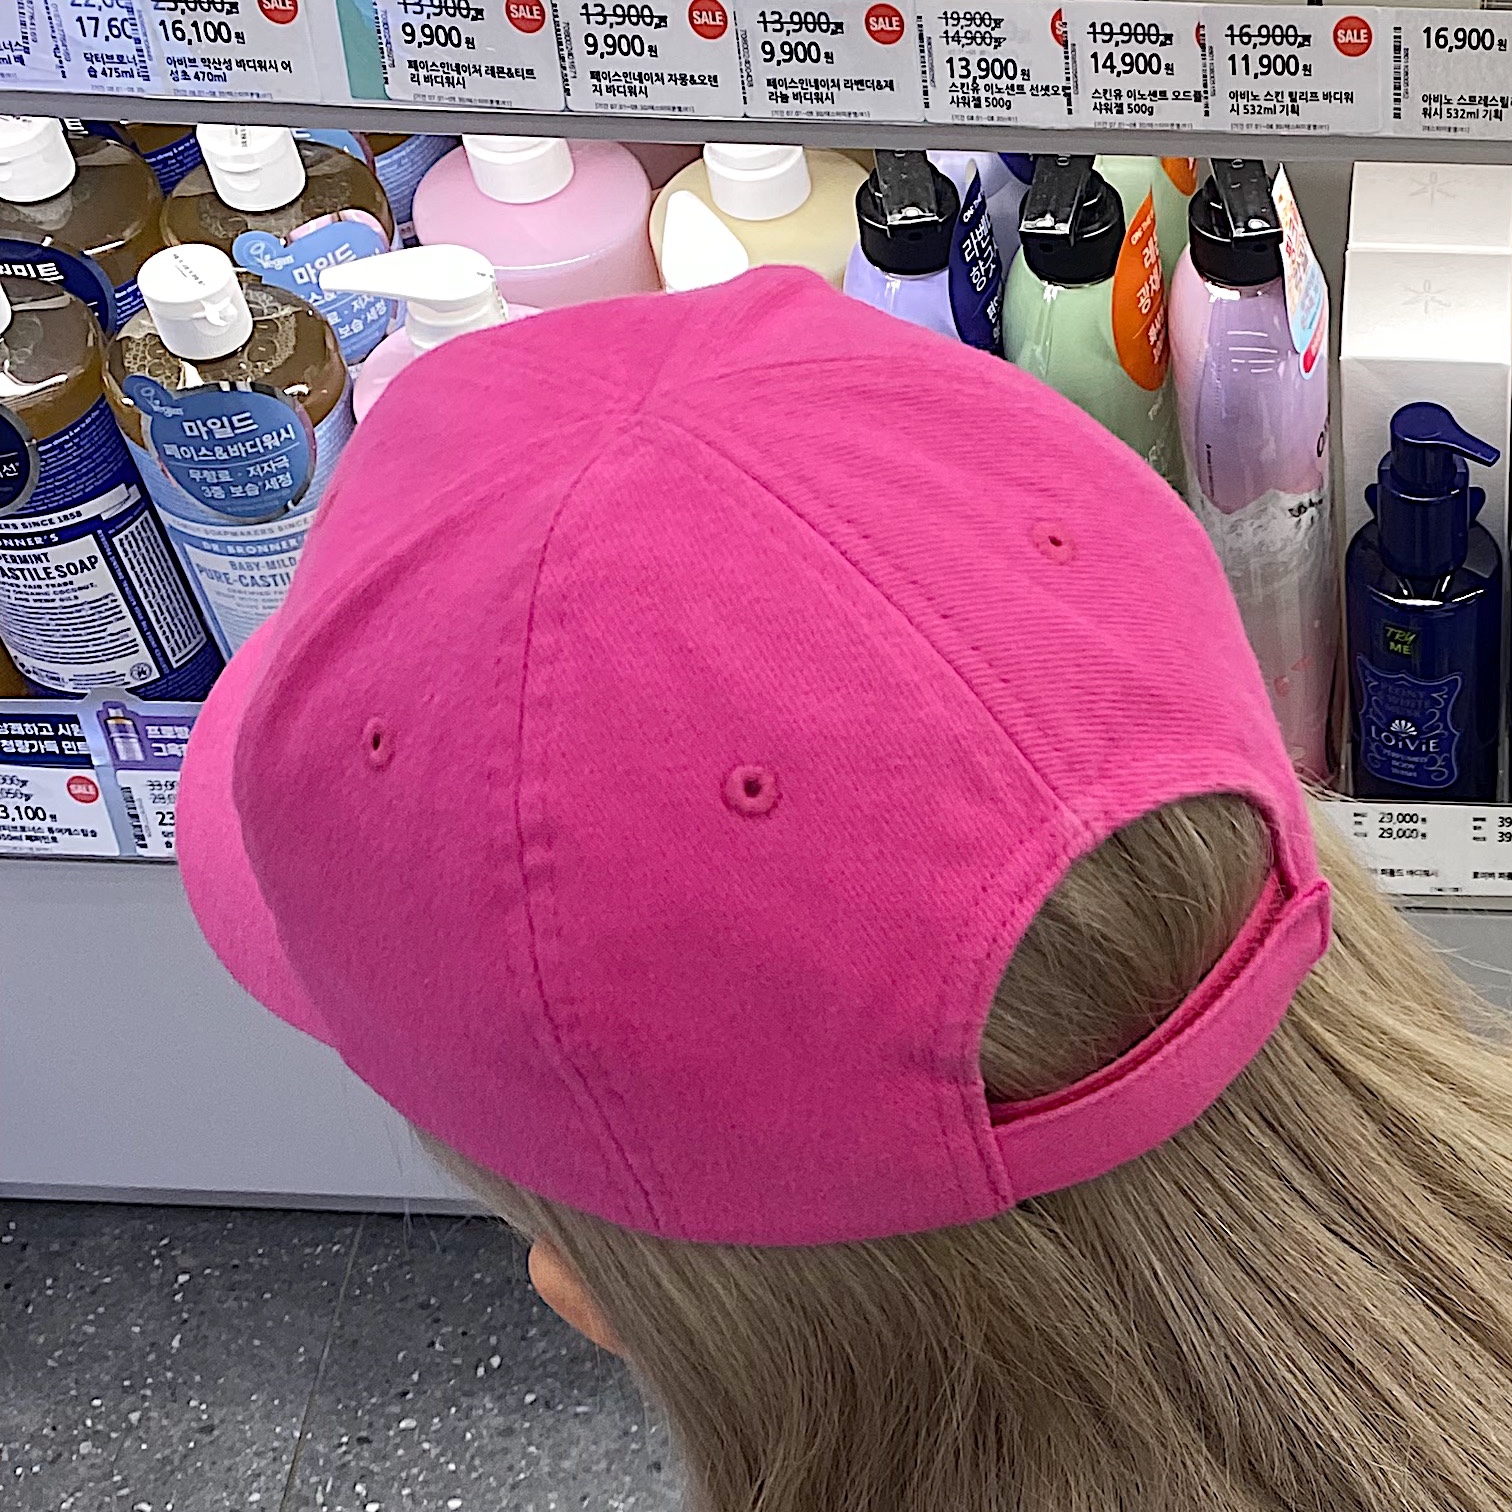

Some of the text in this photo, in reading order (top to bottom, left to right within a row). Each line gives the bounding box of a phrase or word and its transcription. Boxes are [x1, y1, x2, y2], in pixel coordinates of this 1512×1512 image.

[509, 5, 542, 20] SALE
[690, 9, 724, 26] SALE
[158, 19, 246, 46] 16,100원
[868, 15, 901, 33] SALE
[400, 22, 477, 50] 9,900원
[1335, 27, 1369, 44] SALE
[1422, 26, 1508, 54] 16,900원
[583, 32, 659, 60] 9,900원
[760, 40, 835, 68] 9,900원
[235, 58, 280, 74] 바디워시
[944, 56, 1031, 84] 13,900원
[1089, 51, 1175, 78] 14,900원
[1227, 52, 1313, 80] 11,900원
[193, 69, 228, 84] 470ml
[421, 73, 467, 90] 바디워시
[605, 84, 649, 100] 바디워시
[790, 91, 835, 106] 바디워시
[1227, 89, 1355, 104] 아비노 스킨 릴리프 바디워
[1420, 93, 1454, 107] 아비노
[984, 96, 1013, 110] 500g
[1126, 101, 1155, 116] 500g
[1242, 102, 1301, 118] 532ml 기획
[1421, 108, 1504, 122] 워시 532ml 기획
[181, 411, 260, 439] 마일드
[162, 424, 297, 462] 페이스&바디워시
[246, 456, 291, 478] 저자극
[264, 470, 294, 492] 세정
[22, 510, 84, 530] SINCE 1858
[55, 555, 100, 581] SOAP
[229, 556, 298, 572] BABY-MILD
[1384, 625, 1417, 646] TRY
[1389, 641, 1412, 655] ME
